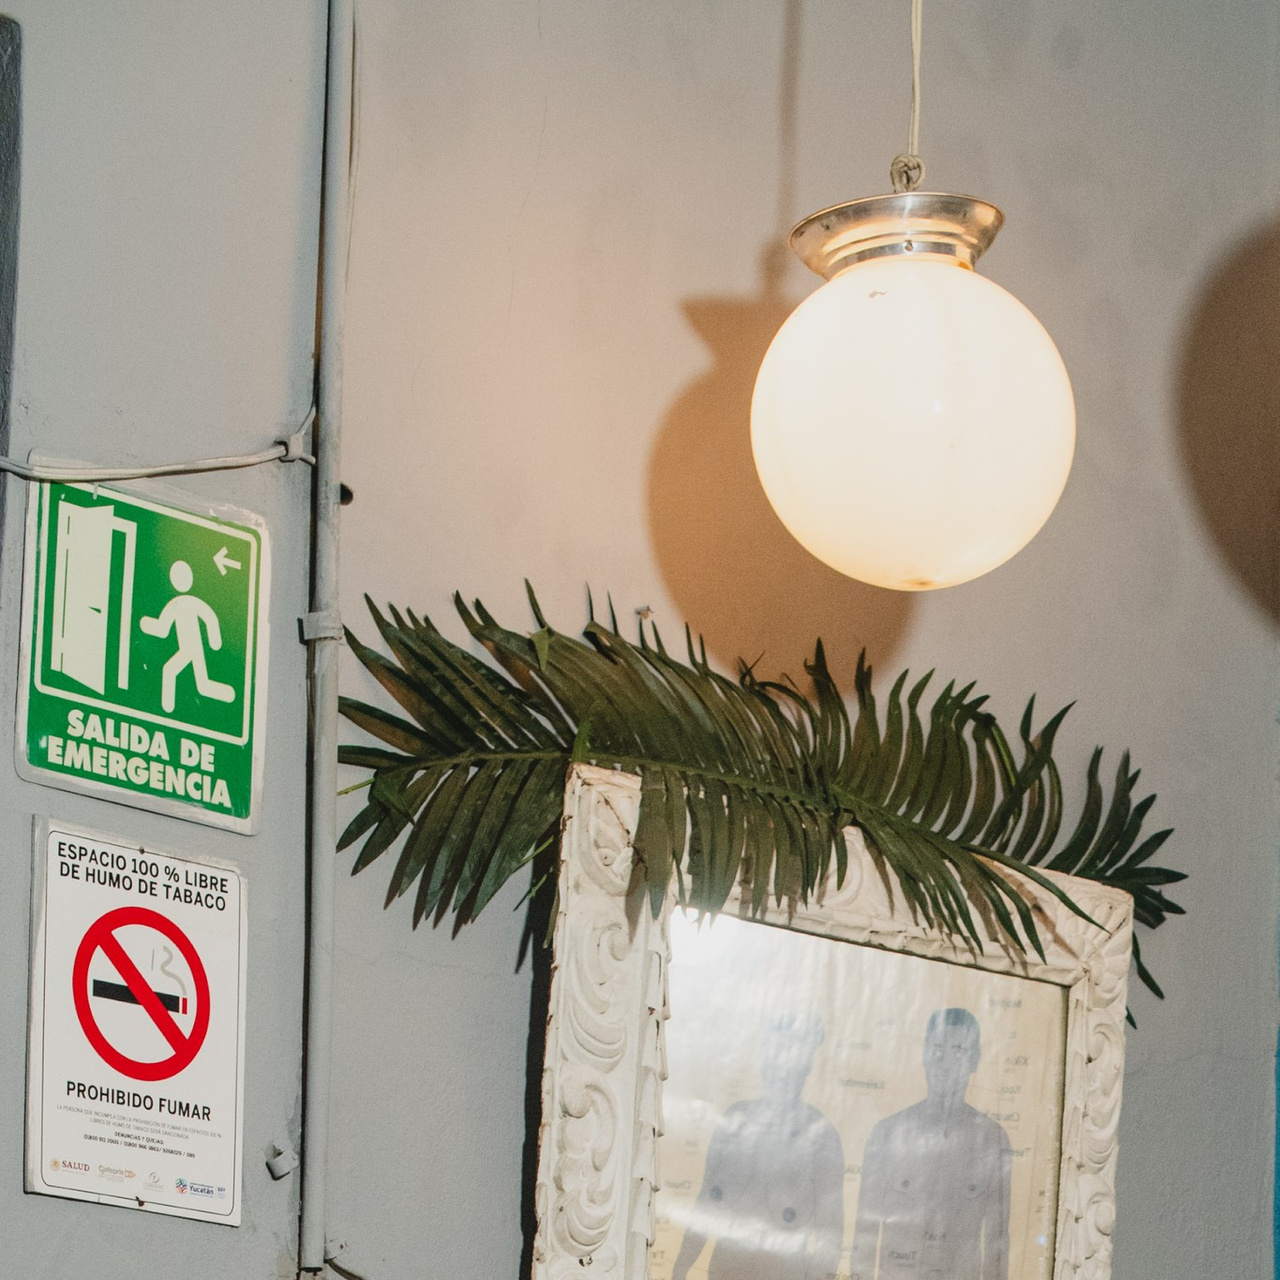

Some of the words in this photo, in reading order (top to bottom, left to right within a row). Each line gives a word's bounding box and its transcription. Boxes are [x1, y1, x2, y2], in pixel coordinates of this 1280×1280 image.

[66, 709, 170, 761] SALIDA
[180, 738, 215, 772] DE
[47, 735, 232, 808] EMERGENCIA
[58, 842, 127, 870] ESPACIO
[131, 858, 159, 878] 100
[164, 865, 180, 883] %
[185, 870, 228, 894] LIBRE
[60, 861, 80, 880] DE
[85, 868, 133, 891] HUMO
[138, 880, 158, 897] DE
[163, 884, 226, 911] TABACO
[66, 1080, 154, 1110] PROHIBIDO
[159, 1098, 211, 1122] FUMAR
[61, 1160, 90, 1172] SALUD
[189, 1184, 214, 1196] Yucatán
